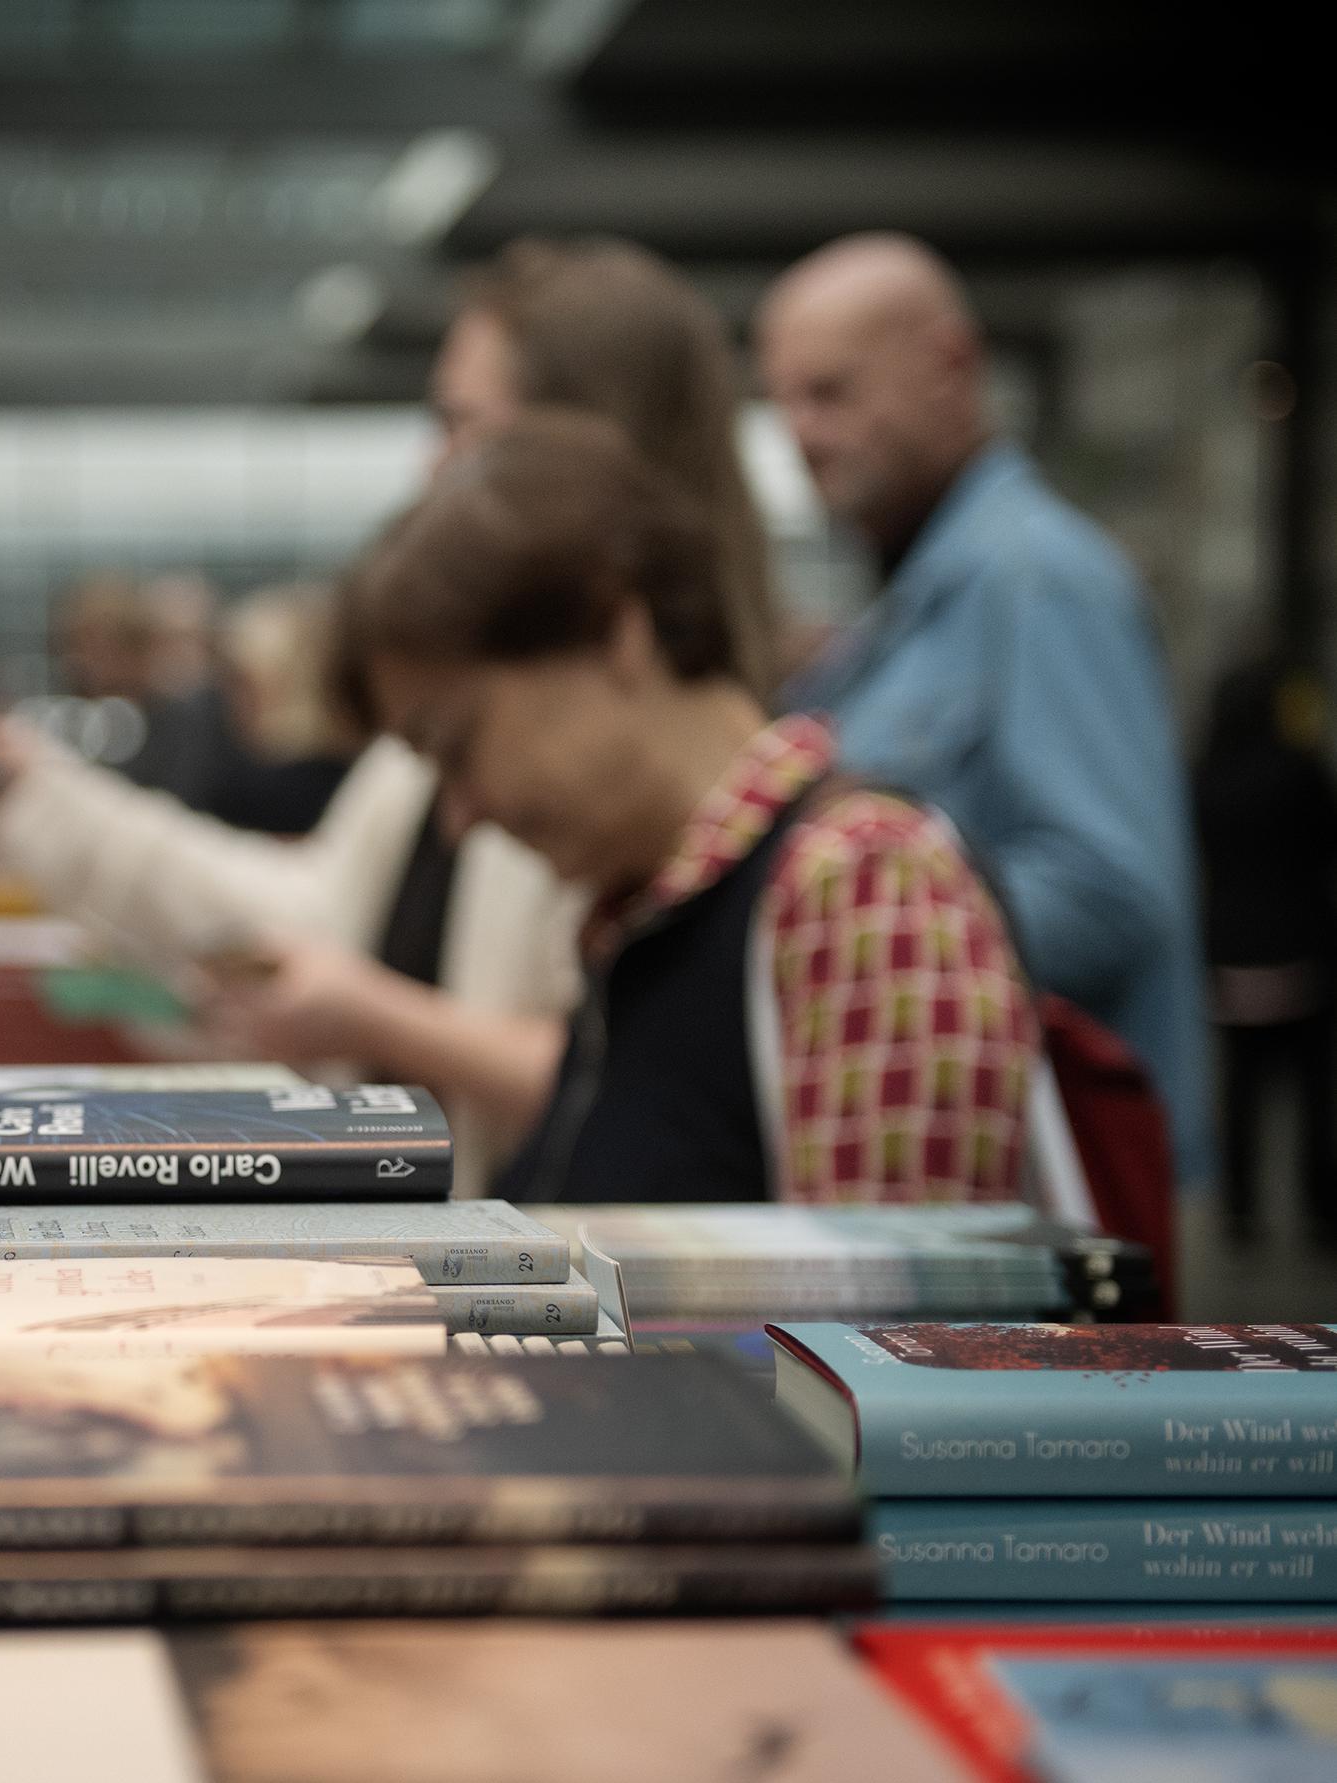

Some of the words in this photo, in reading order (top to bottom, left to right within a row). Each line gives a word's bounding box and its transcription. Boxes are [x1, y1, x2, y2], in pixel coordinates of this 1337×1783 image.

[69, 1154, 179, 1186] Rovelli
[189, 1154, 282, 1185] Carlo
[518, 1252, 534, 1272] 29
[545, 1303, 561, 1323] 29
[1157, 1326, 1252, 1349] Wind
[1229, 1351, 1300, 1372] Der
[1165, 1418, 1213, 1442] Der
[1222, 1417, 1292, 1442] Wind
[901, 1430, 1017, 1460] Susanna
[1025, 1431, 1131, 1460] Tamaro
[1165, 1450, 1243, 1474] wohin
[1250, 1455, 1280, 1473] er
[1288, 1449, 1334, 1473] will
[1143, 1521, 1195, 1546] Der
[1201, 1521, 1271, 1547] Wind
[877, 1532, 995, 1563] Susanna
[1003, 1534, 1109, 1564] Tamaro
[1143, 1553, 1222, 1579] wohin
[1229, 1560, 1261, 1578] er
[1268, 1553, 1315, 1578] will
